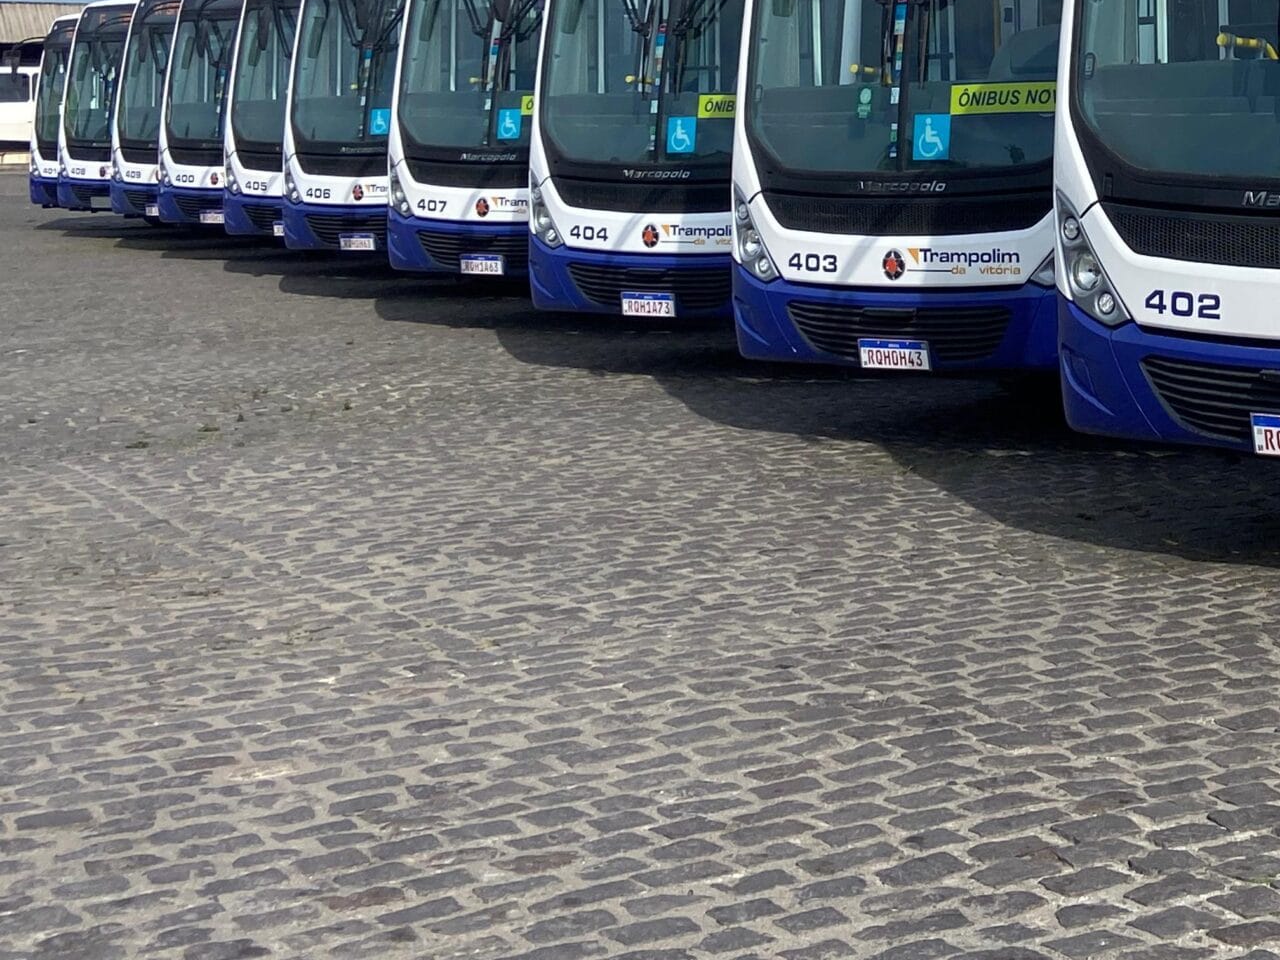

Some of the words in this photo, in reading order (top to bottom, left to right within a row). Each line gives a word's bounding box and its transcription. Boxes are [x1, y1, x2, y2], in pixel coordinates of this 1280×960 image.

[958, 88, 1021, 107] ÔNIBUS
[175, 174, 195, 183] 400
[245, 180, 268, 191] 405
[306, 187, 331, 199] 406
[417, 198, 447, 212] 407
[570, 225, 609, 241] 404
[789, 253, 837, 273] 403
[919, 248, 1020, 267] Trampolim
[951, 265, 966, 275] da
[979, 265, 1021, 275] vitória
[628, 300, 671, 315] RQH1A73
[1145, 290, 1221, 320] 402
